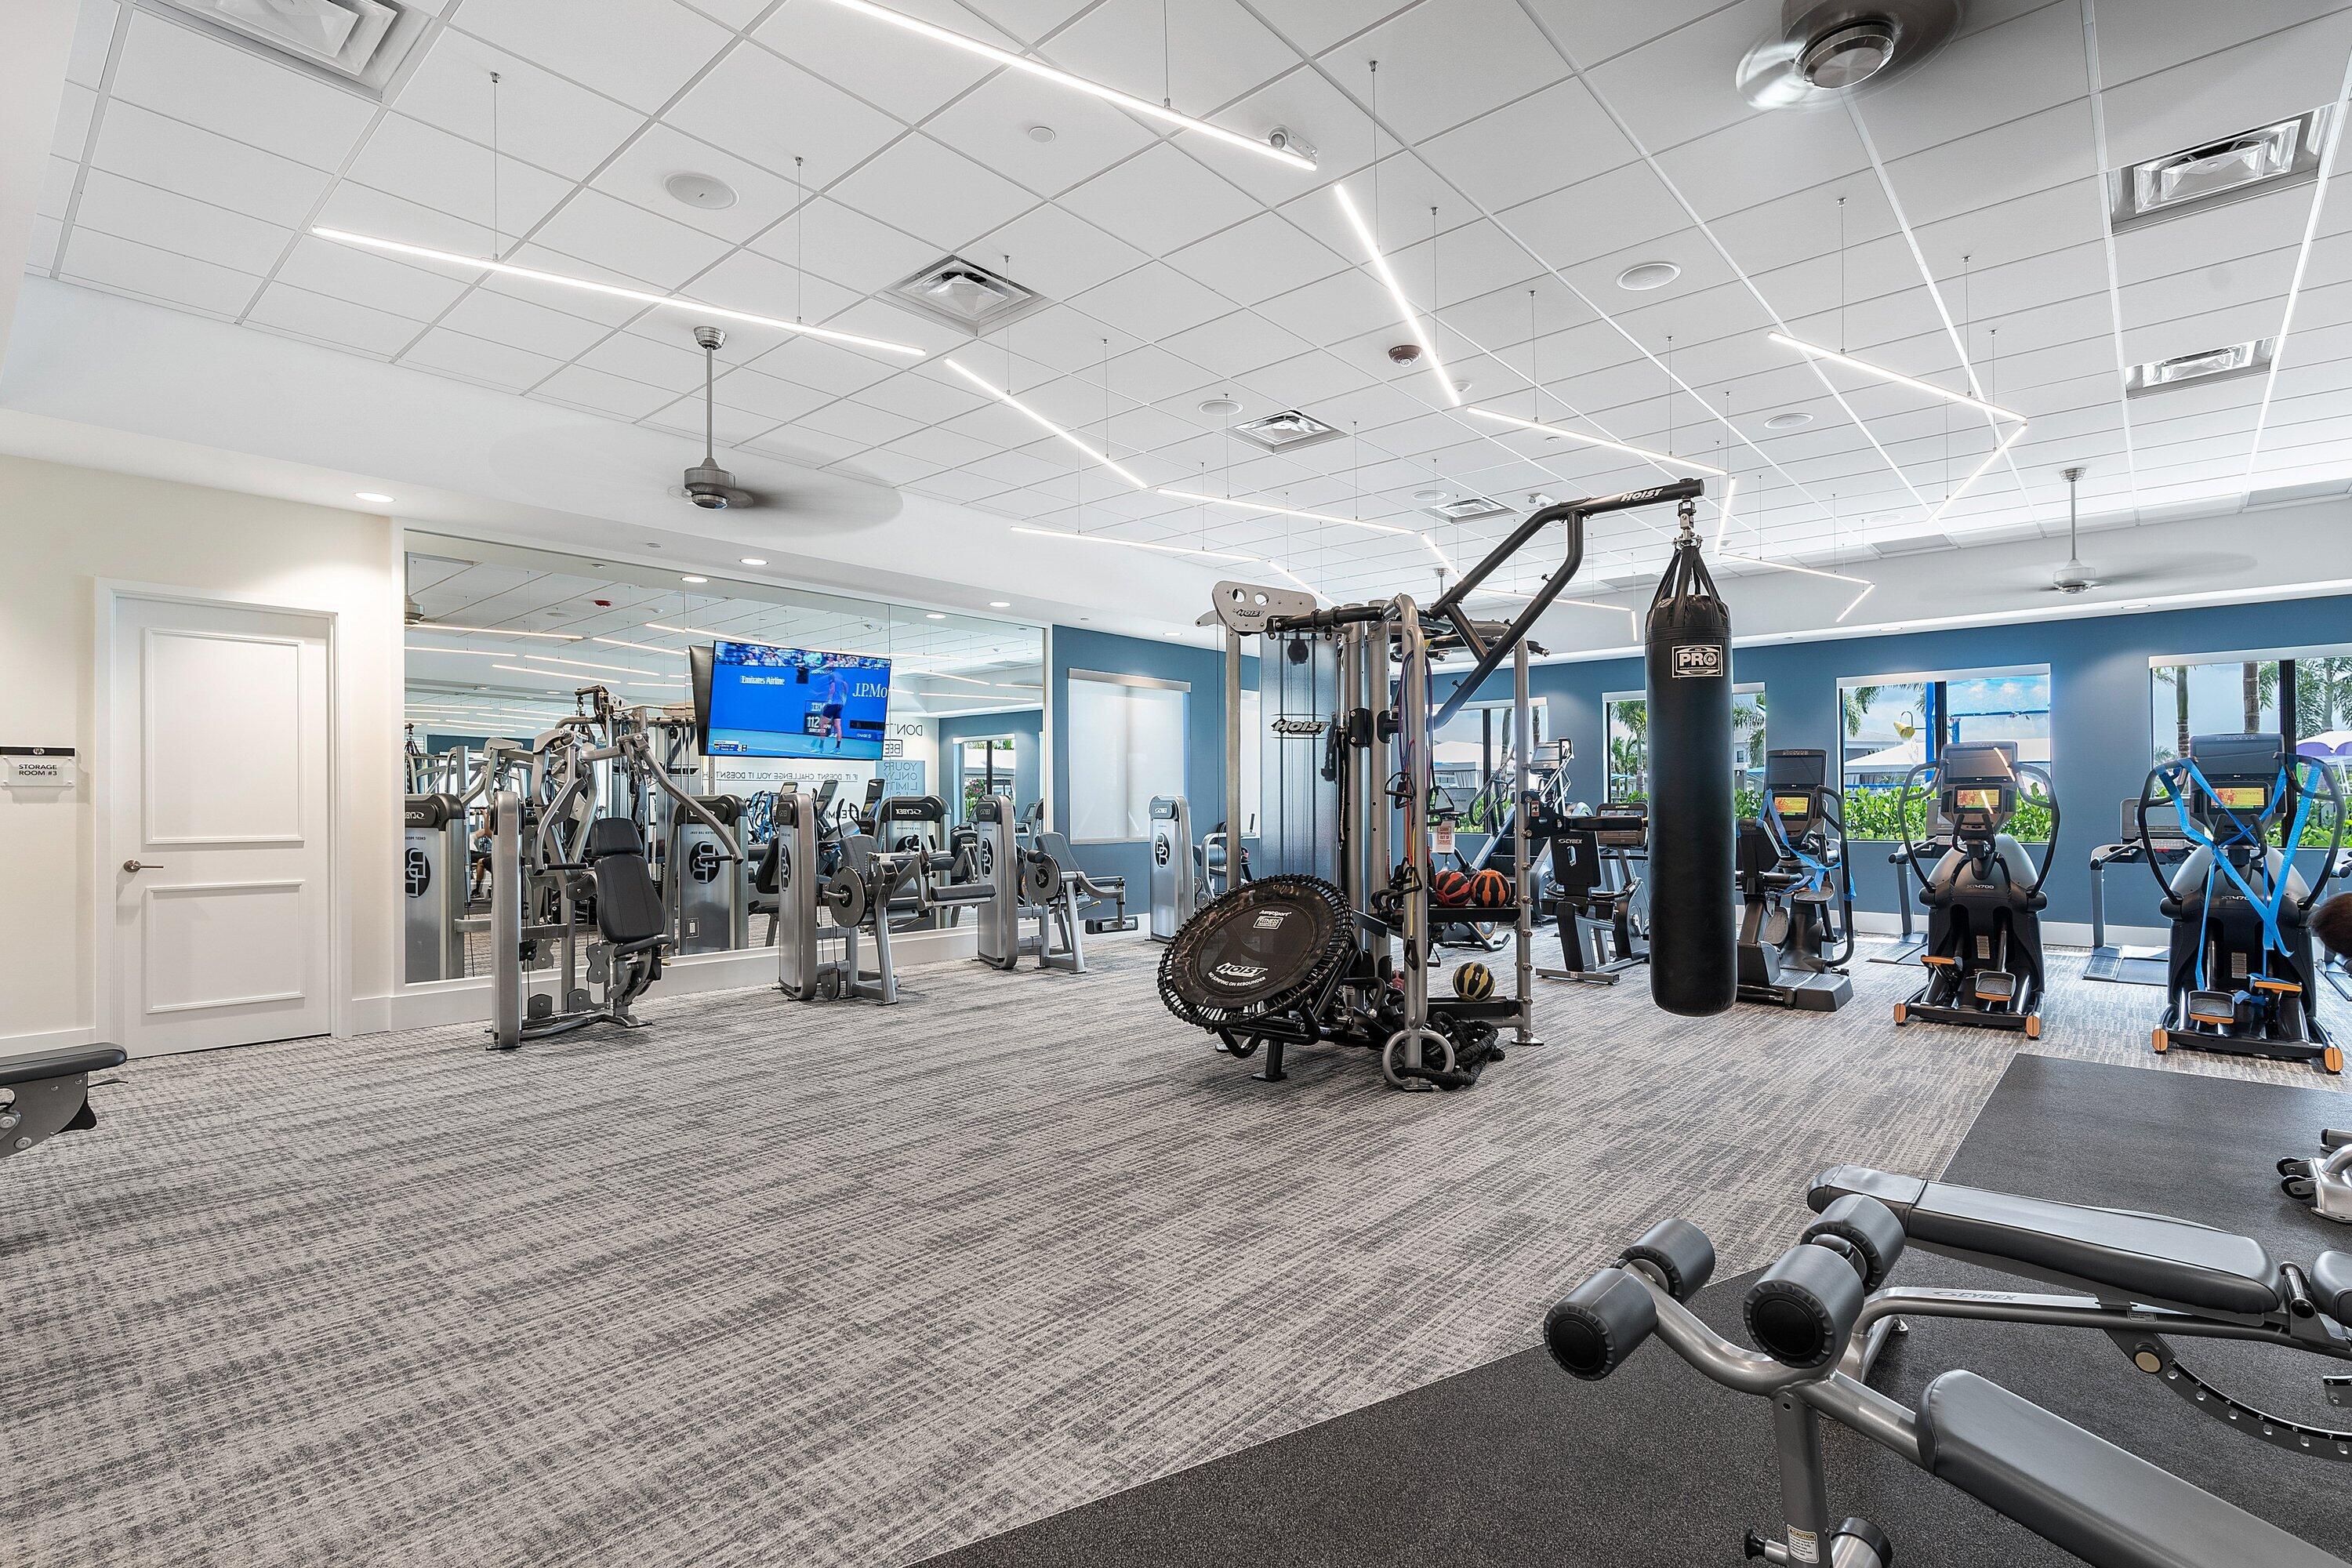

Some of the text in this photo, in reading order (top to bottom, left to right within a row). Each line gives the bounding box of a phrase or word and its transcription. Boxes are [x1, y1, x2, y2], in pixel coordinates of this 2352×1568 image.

[1620, 488, 1664, 503] HOIST
[1236, 608, 1265, 618] HOIST
[1679, 652, 1717, 666] PRO
[807, 716, 820, 728] 112
[1273, 720, 1331, 731] HOIST
[1218, 964, 1265, 975] HOIST
[1236, 976, 1266, 986] REBOUNDER
[1957, 1292, 2018, 1301] CYBEX
[1793, 1530, 1815, 1539] CAUTION
